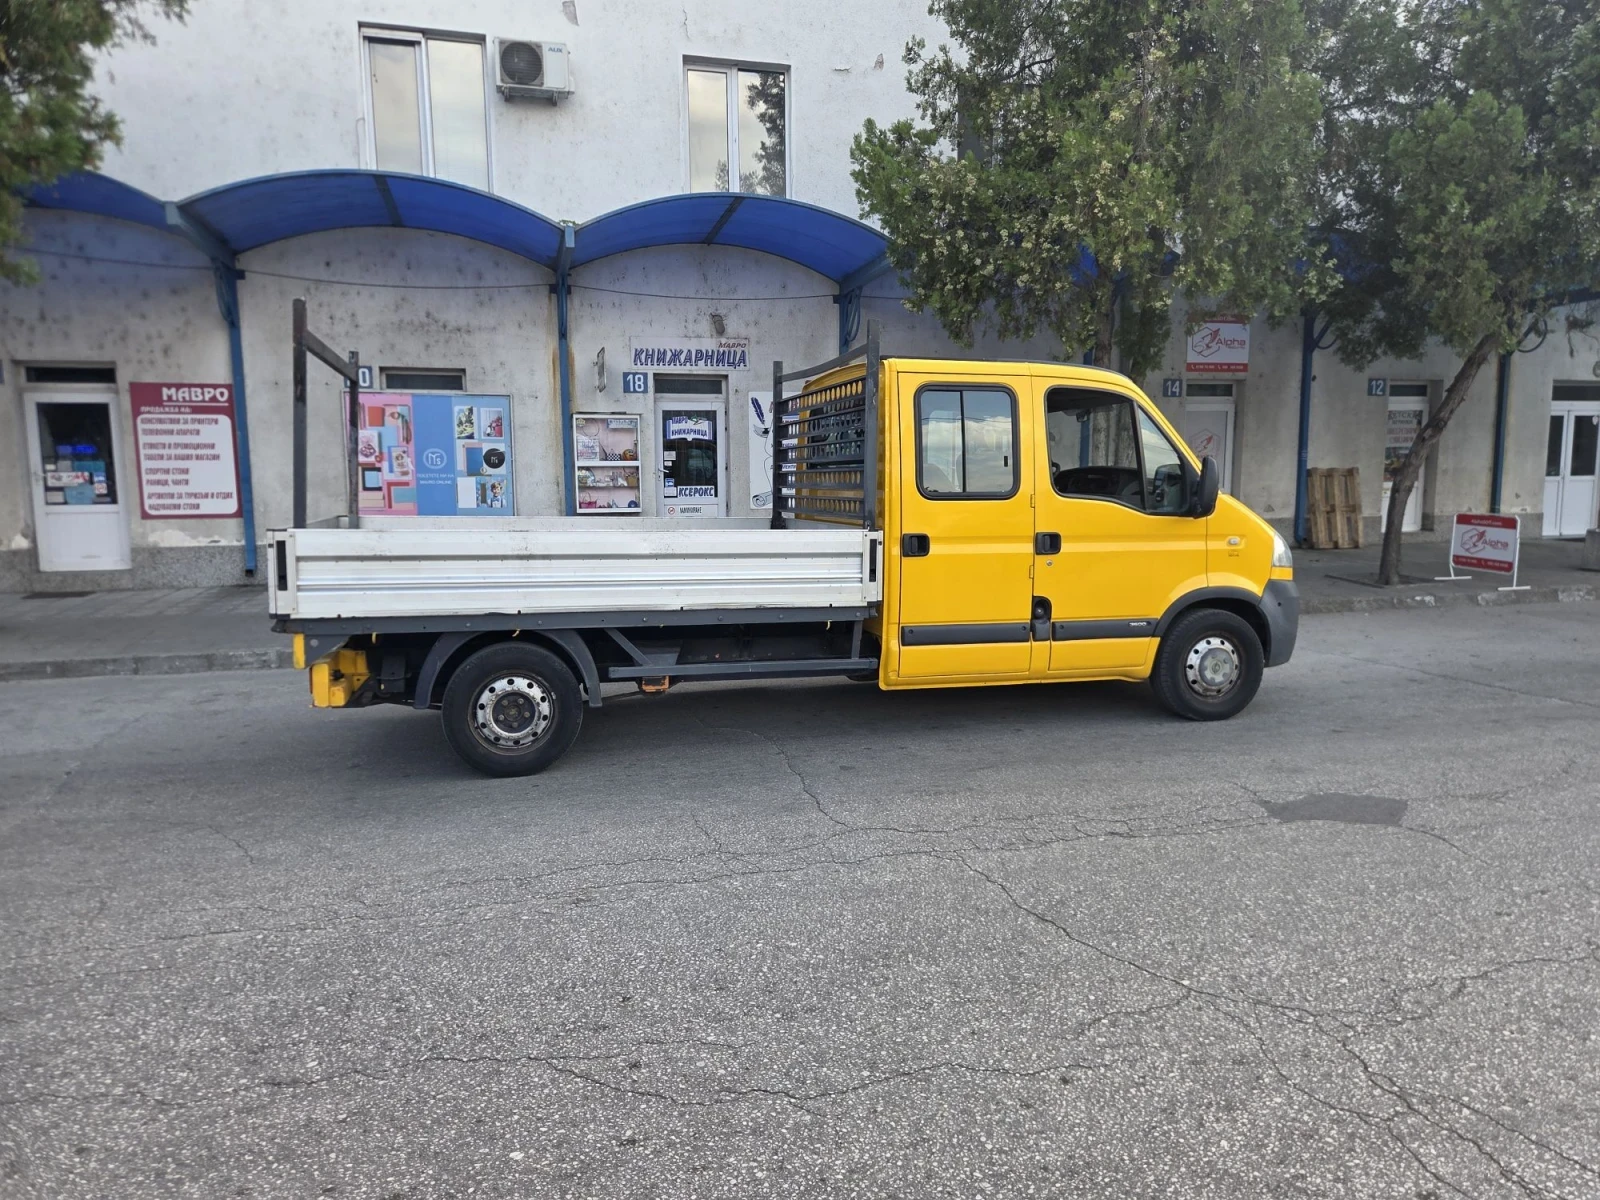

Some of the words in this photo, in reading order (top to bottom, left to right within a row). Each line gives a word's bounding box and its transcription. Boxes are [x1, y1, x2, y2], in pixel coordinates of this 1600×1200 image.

[1215, 337, 1246, 347] Alpha
[633, 347, 748, 369] КНИЖАРНИЦА
[626, 374, 645, 392] 18
[1166, 380, 1180, 396] 14
[1370, 380, 1384, 395] 12
[162, 387, 229, 402] МАВРО
[671, 428, 708, 437] КНИЖАРНИЦА
[678, 486, 714, 497] КСЕРОКС
[1481, 538, 1509, 549] Alpha
